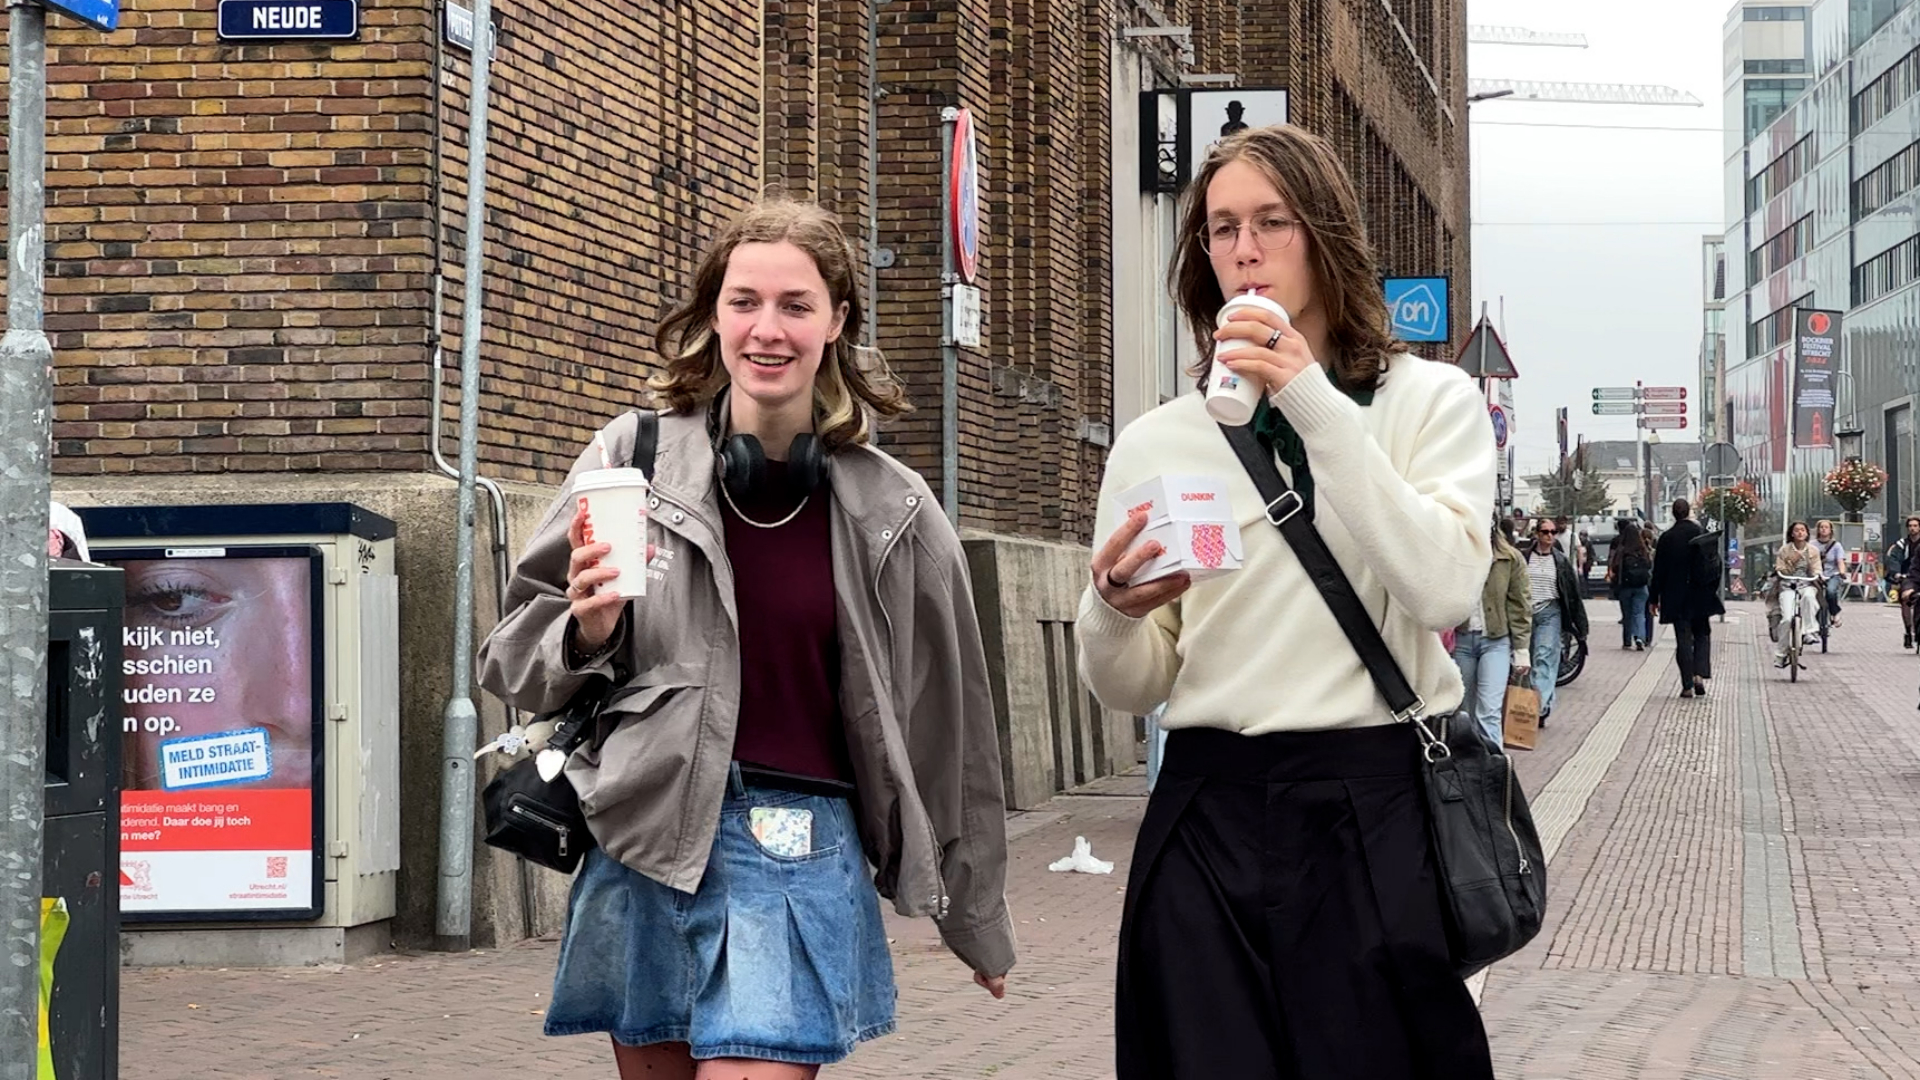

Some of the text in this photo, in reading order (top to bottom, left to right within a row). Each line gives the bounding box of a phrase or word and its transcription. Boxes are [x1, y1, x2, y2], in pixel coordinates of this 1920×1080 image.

[253, 6, 322, 29] NEUDE
[170, 626, 220, 649] niet,
[122, 654, 212, 675] sschien
[122, 683, 216, 704] uden ze
[144, 716, 181, 736] op.
[169, 740, 261, 763] MELD STRAAT-
[178, 758, 255, 779] INTIMIDATIE
[165, 803, 197, 813] maakt
[199, 803, 224, 814] bang
[226, 804, 239, 812] en
[163, 817, 190, 826] Daar
[191, 816, 212, 826] doe
[214, 816, 224, 828] jij
[227, 816, 251, 826] toch
[131, 830, 161, 840] mee?
